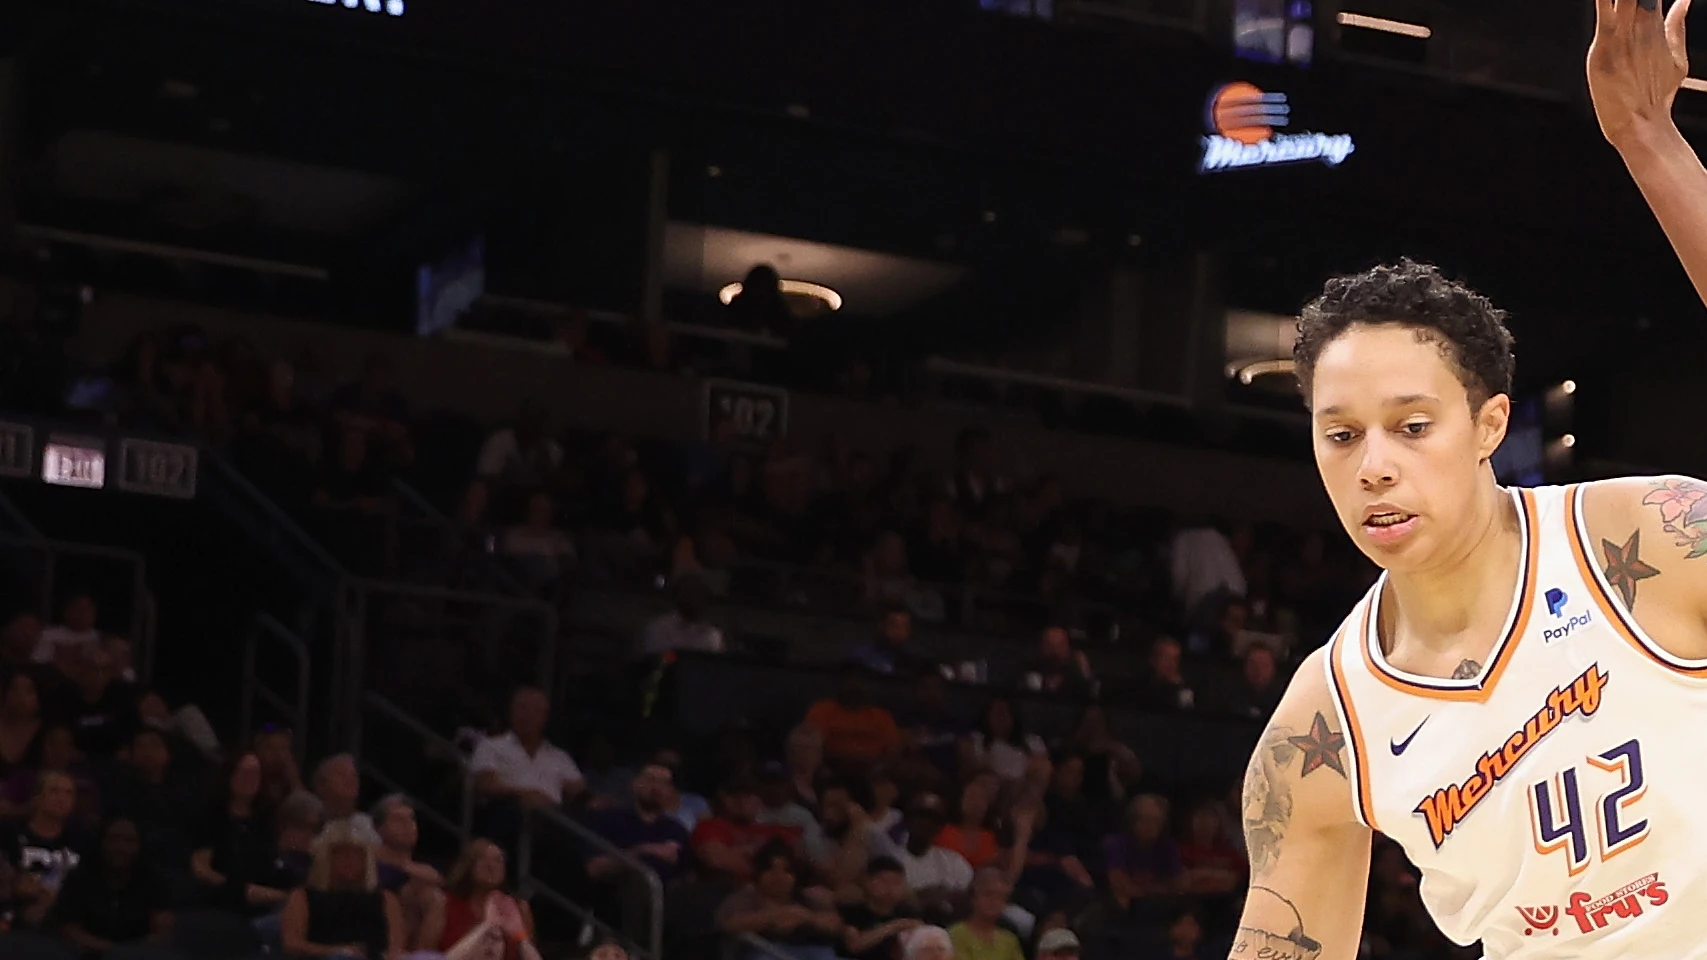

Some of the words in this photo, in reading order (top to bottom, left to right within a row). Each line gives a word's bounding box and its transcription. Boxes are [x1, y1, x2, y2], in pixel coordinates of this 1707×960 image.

[1543, 609, 1592, 643] PayPal
[1412, 661, 1609, 850] Mercury
[1527, 738, 1652, 877] 42
[1618, 873, 1657, 898] STORES
[1585, 894, 1615, 912] FOOD
